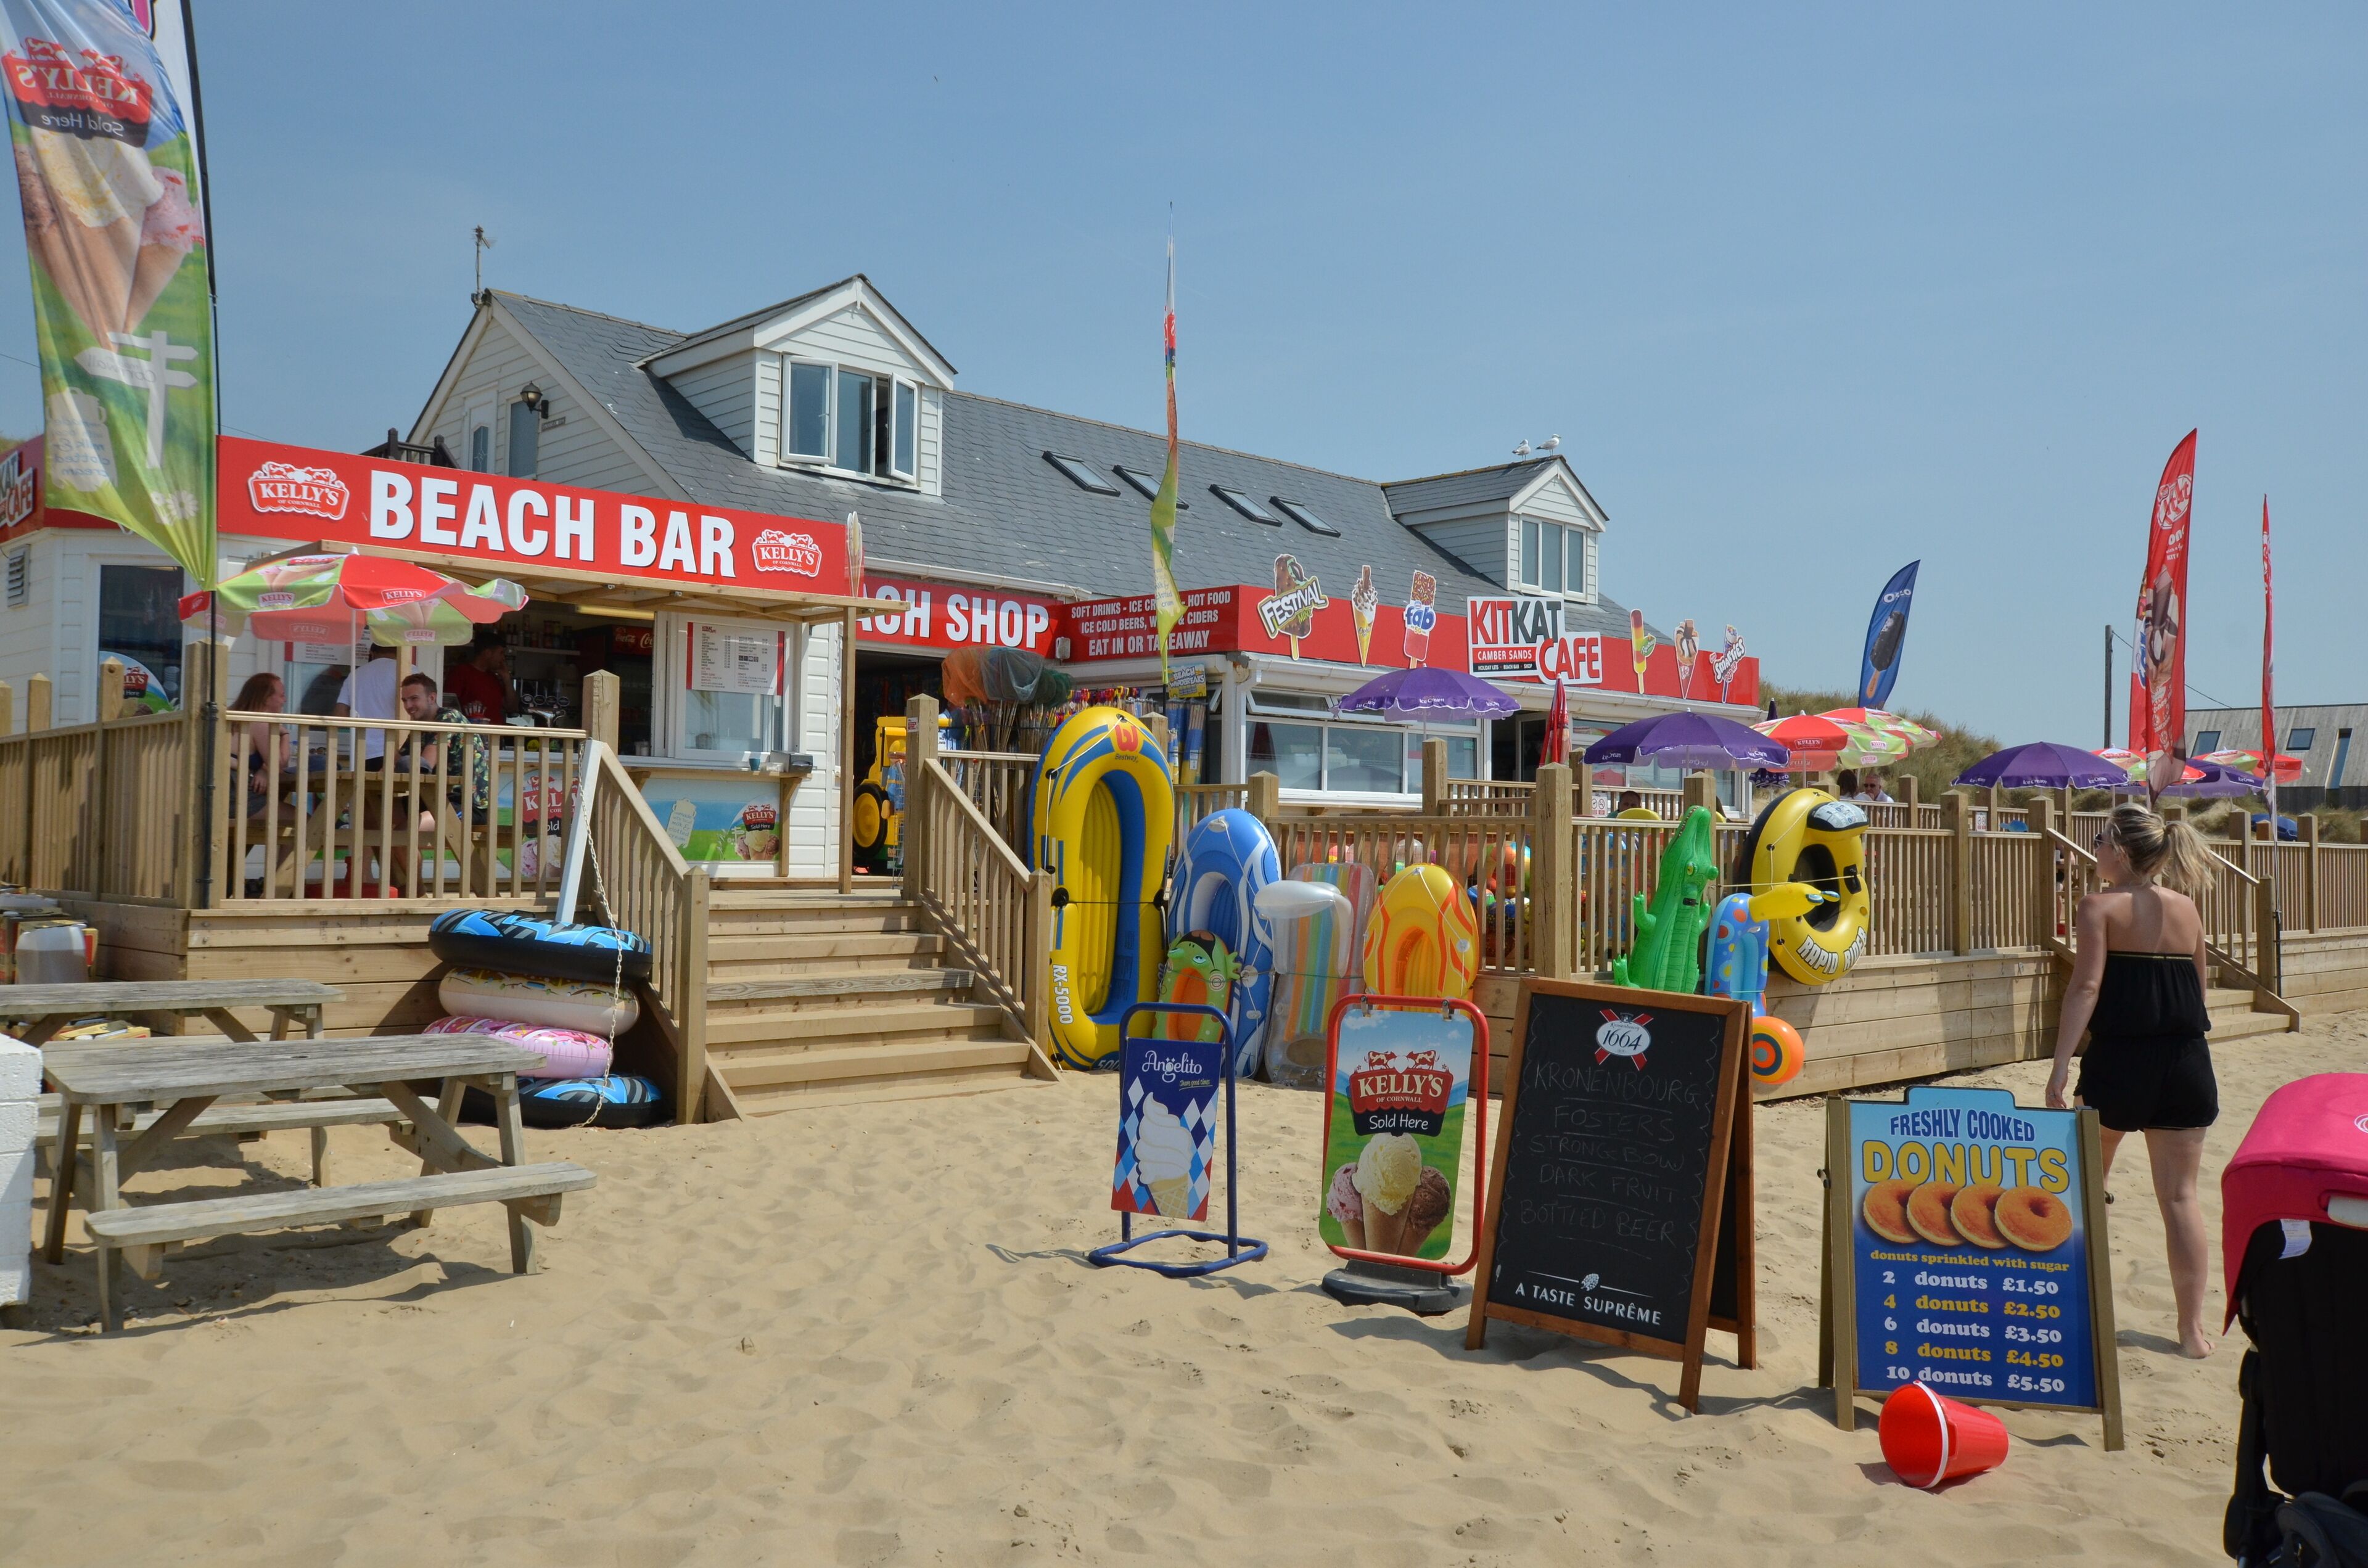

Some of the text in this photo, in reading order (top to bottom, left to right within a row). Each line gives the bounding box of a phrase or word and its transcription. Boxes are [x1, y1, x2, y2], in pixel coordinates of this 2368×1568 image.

[258, 483, 339, 506] KELLY'S
[287, 499, 321, 508] CORNWALL
[371, 470, 736, 578] BEACH BAR
[760, 546, 815, 565] KELLY'S
[261, 592, 292, 602] KELLY'S
[385, 590, 423, 599] KELLY'S
[1071, 605, 1091, 618] SOFT
[1093, 602, 1121, 616] DRINKS
[1129, 600, 1143, 614] ICE
[1188, 593, 1205, 607] HOT
[1207, 591, 1231, 606] FOOD
[946, 593, 1049, 649] SHOP
[1082, 621, 1095, 634] ICE
[1096, 619, 1117, 633] COLD
[1119, 616, 1148, 631] BEERS,
[1178, 613, 1185, 625] &
[1187, 609, 1219, 624] CIDERS
[1405, 605, 1436, 630] fab
[1470, 600, 1561, 644] KITKAT
[1089, 639, 1109, 656] EAT
[1112, 638, 1124, 654] IN
[1127, 636, 1144, 653] OR
[1478, 649, 1532, 661] CAMBER SANDS
[1539, 637, 1600, 680] CAFE
[1169, 675, 1204, 688] WINDBREAKS
[1174, 666, 1196, 680] BEACH
[1115, 753, 1138, 763] Bestway
[746, 811, 774, 820] KELLY'S
[1796, 934, 1839, 975] RAPID
[1842, 926, 1867, 972] RIDER
[1052, 964, 1074, 1025] RX-5000
[1603, 1028, 1643, 1051] 1664
[1141, 1050, 1202, 1083] Angelito
[1191, 1078, 1200, 1087] good
[1357, 1073, 1444, 1099] KELLY'S
[1535, 1060, 1702, 1110] KRONENBOURG
[1388, 1095, 1423, 1104] CORNWALL
[1369, 1114, 1429, 1130] Sold Here
[1554, 1105, 1675, 1142] FOSTERS
[1889, 1107, 2036, 1143] FRESHLY COOKED
[1861, 1139, 2070, 1194] DONUTS
[1539, 1164, 1679, 1204] DARK FRUIT
[1520, 1199, 1677, 1248] BOTTLED BEER
[1870, 1249, 2070, 1273] donuts sprinkled with sugar
[1882, 1270, 2059, 1295] 2 donuts £1.50
[1515, 1283, 1662, 1327] A TASTE SUPRÊME
[1883, 1294, 2061, 1320] 4 donuts £2.50
[1884, 1316, 2062, 1344] 6 donuts £3.50
[1885, 1340, 2063, 1368] 8 donuts £4.50
[1886, 1365, 2065, 1393] 10 donuts £5.50
